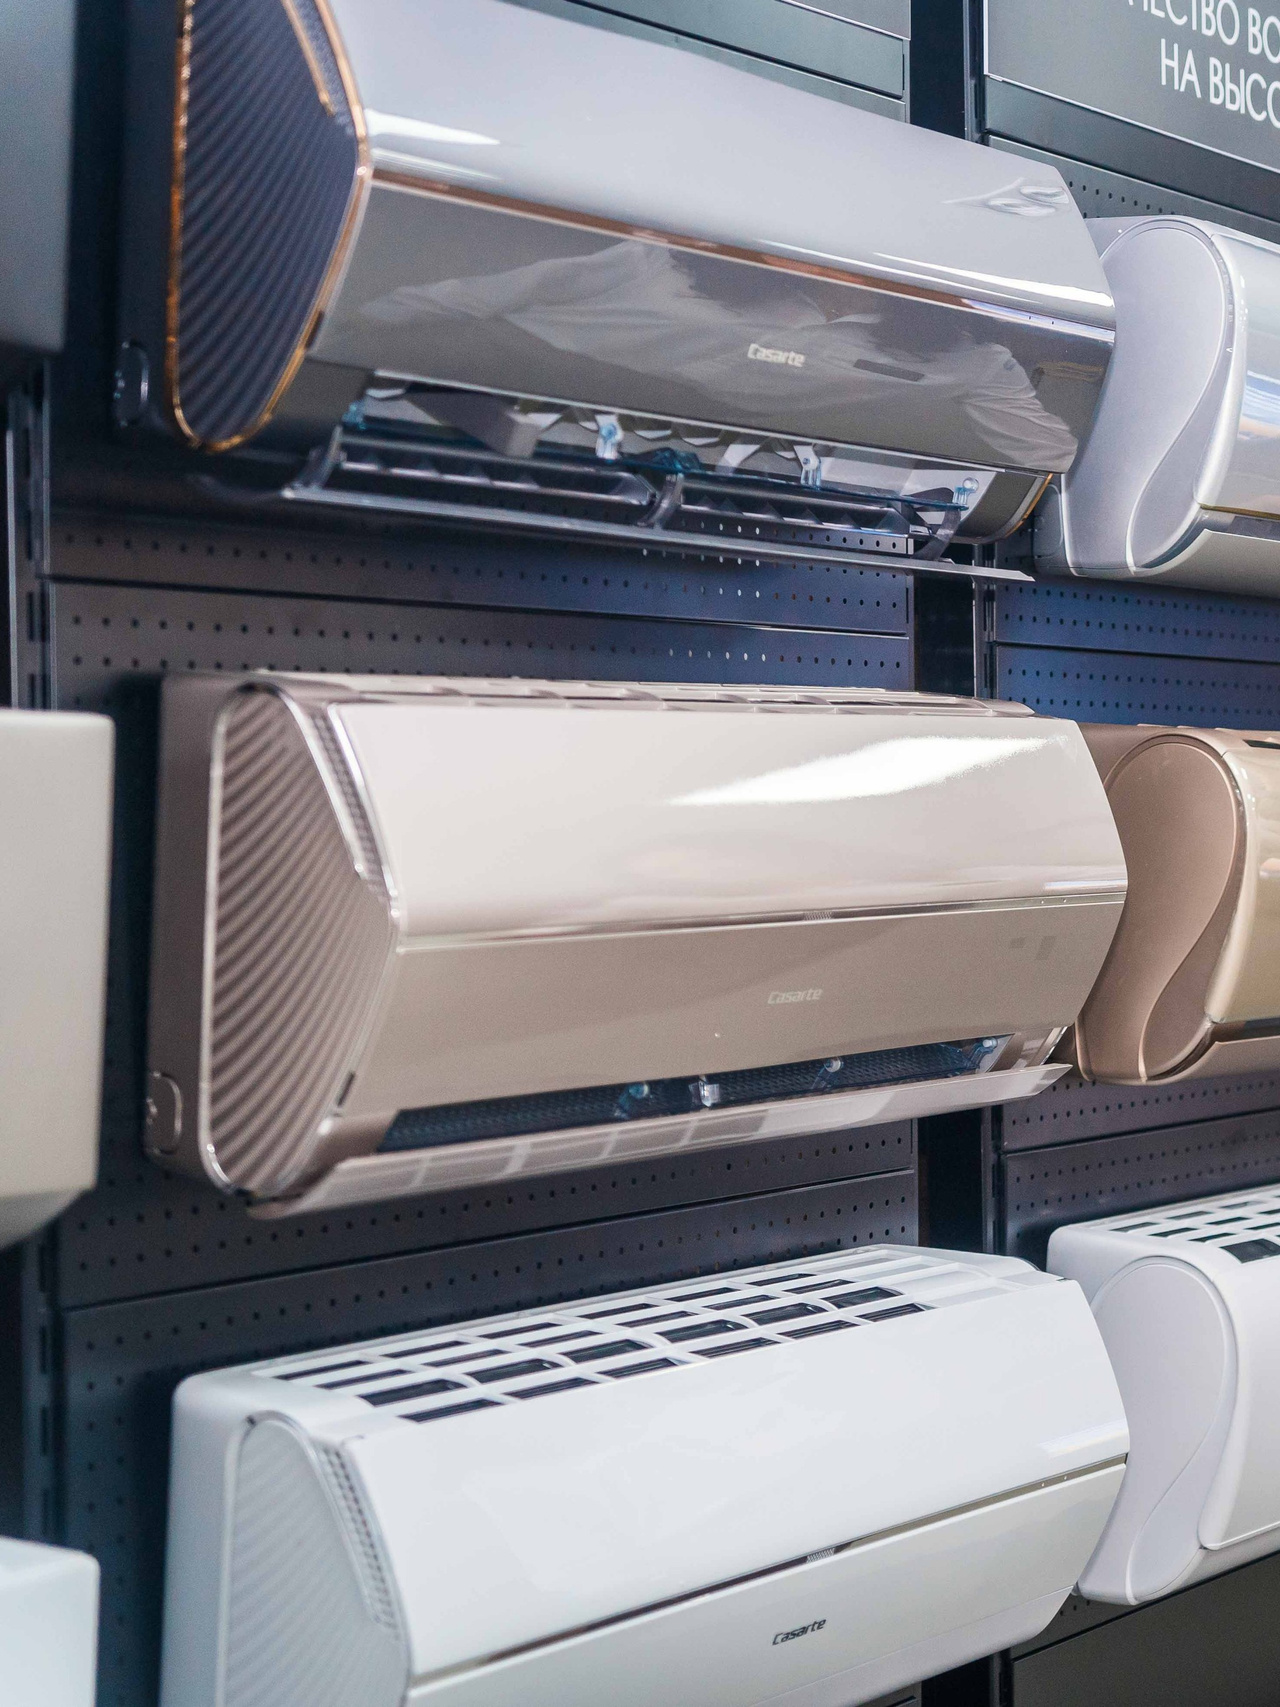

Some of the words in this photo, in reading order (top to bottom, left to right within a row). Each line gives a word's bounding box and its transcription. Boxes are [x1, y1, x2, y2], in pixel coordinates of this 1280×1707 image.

[1161, 38, 1201, 98] НА
[747, 343, 805, 368] Casarte
[768, 989, 823, 1004] Casarte
[772, 1619, 826, 1646] Casarte
